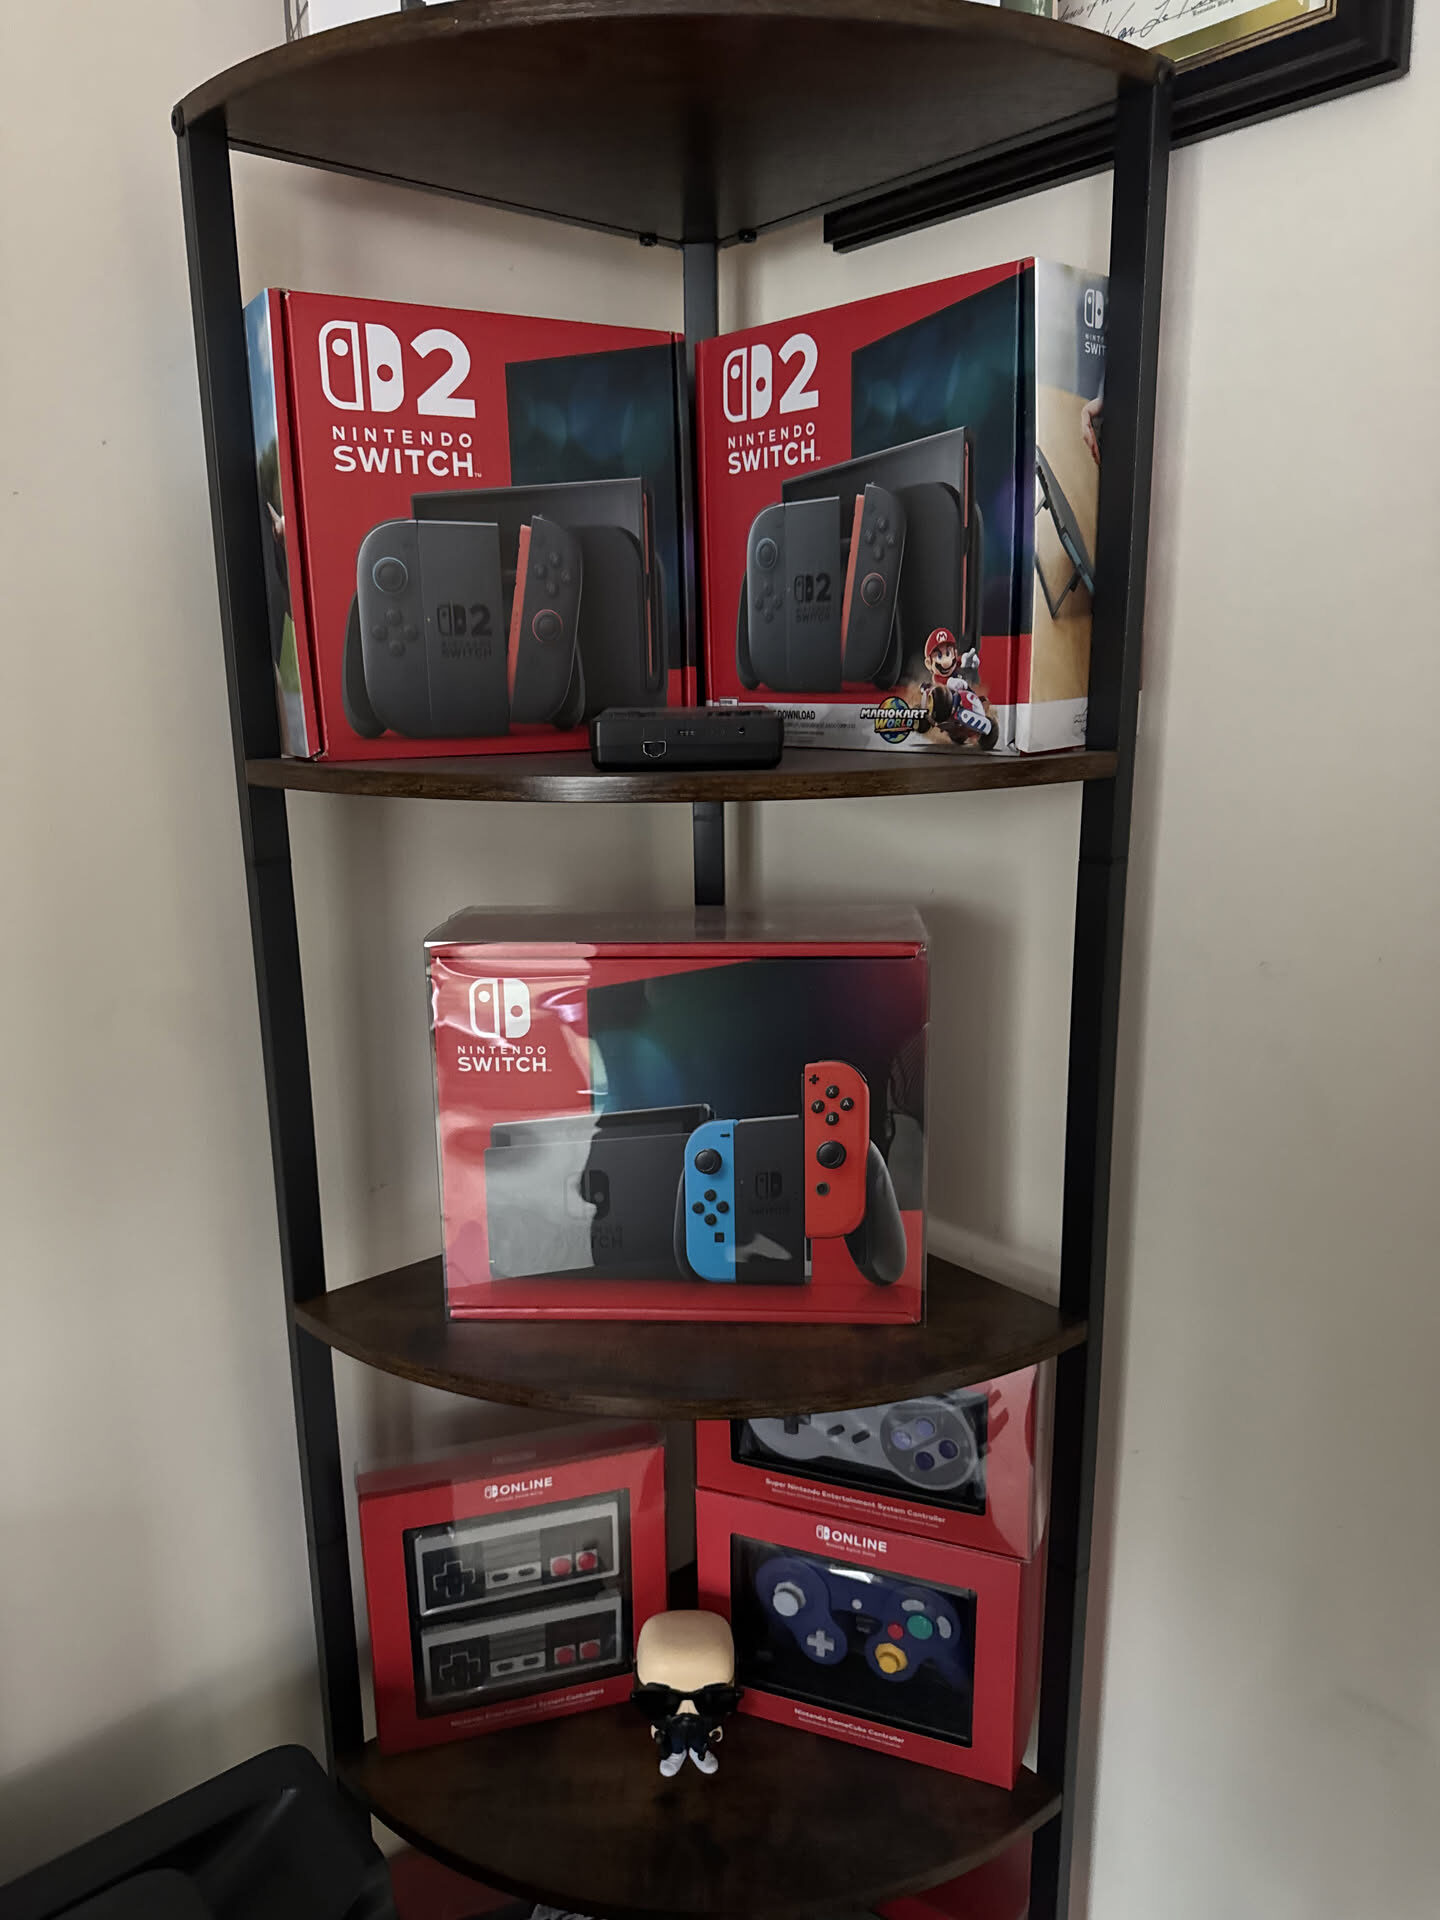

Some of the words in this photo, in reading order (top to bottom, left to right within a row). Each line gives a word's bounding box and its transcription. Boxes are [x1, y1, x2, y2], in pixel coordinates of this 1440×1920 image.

[410, 328, 476, 419] 2
[778, 333, 819, 414] 2
[332, 425, 473, 448] NINTENDO
[727, 422, 815, 449] NINTENDO
[333, 445, 474, 478] SWITCH
[728, 439, 815, 475] SWITCH
[777, 710, 816, 720] DOWNLOAD
[875, 718, 914, 729] WORLD
[457, 1045, 547, 1055] NINTENDO
[457, 1056, 547, 1073] SWITCH
[828, 1087, 835, 1095] X
[842, 1099, 850, 1107] A
[828, 1114, 834, 1122] B
[499, 1476, 553, 1495] ONLINE
[831, 1530, 888, 1553] ONLINE
